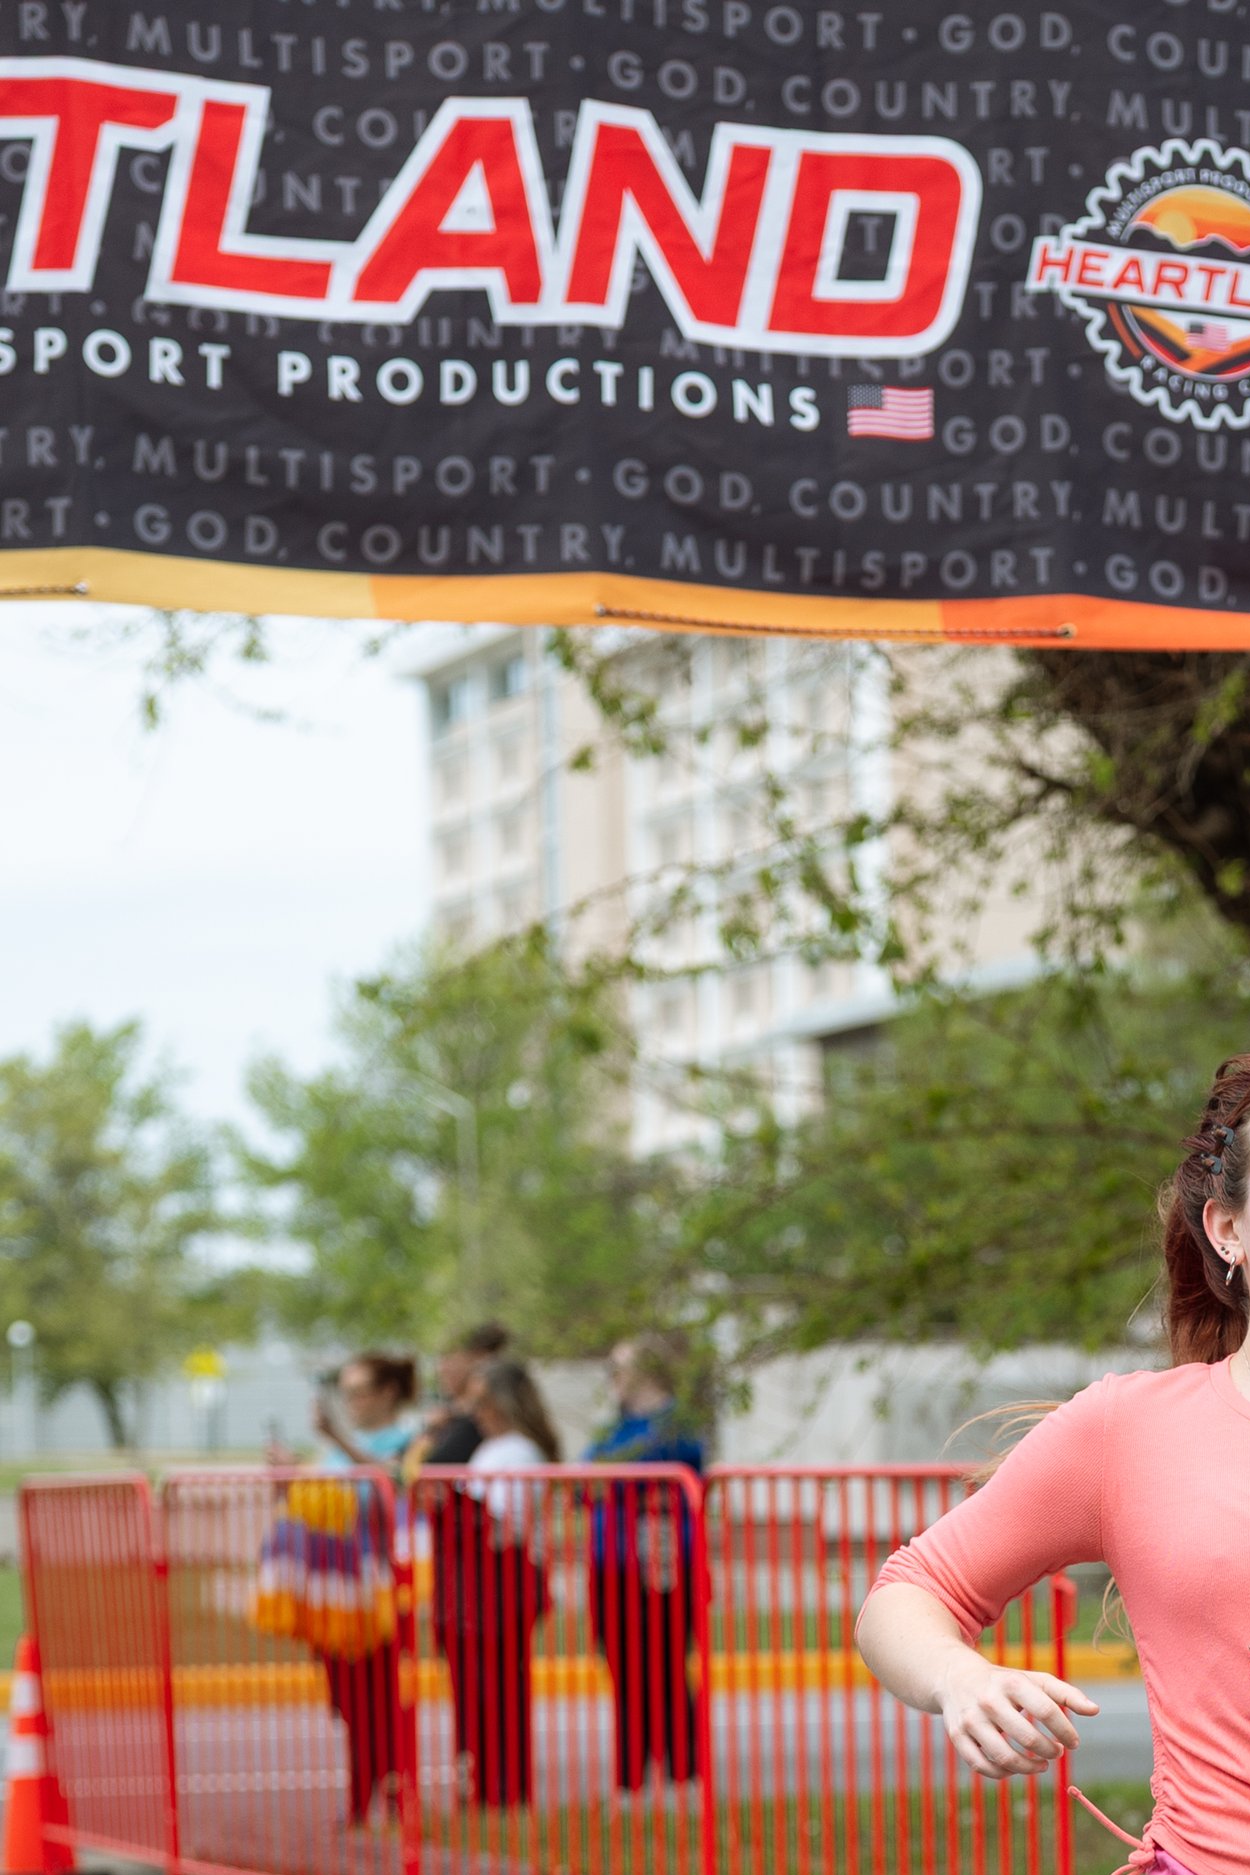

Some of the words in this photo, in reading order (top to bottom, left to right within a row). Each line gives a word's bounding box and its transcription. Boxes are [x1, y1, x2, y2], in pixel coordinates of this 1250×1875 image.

[126, 11, 549, 82] MULTISPORT
[608, 50, 755, 111] GOD,
[781, 75, 1081, 123] COUNTRY,
[939, 12, 1081, 56] GOD,
[1105, 167, 1197, 240] MULTISPORT
[277, 350, 822, 432] PRODUCTIONS
[1139, 354, 1230, 400] RACING
[942, 414, 1079, 457] GOD,
[133, 432, 555, 497] MULTISPORT
[613, 457, 761, 517] GOD,
[789, 478, 1081, 524] COUNTRY,
[134, 503, 289, 560] GOD,
[317, 522, 635, 568] COUNTRY,
[660, 532, 1055, 590] MULTISPORT
[1104, 553, 1238, 606] GOD,
